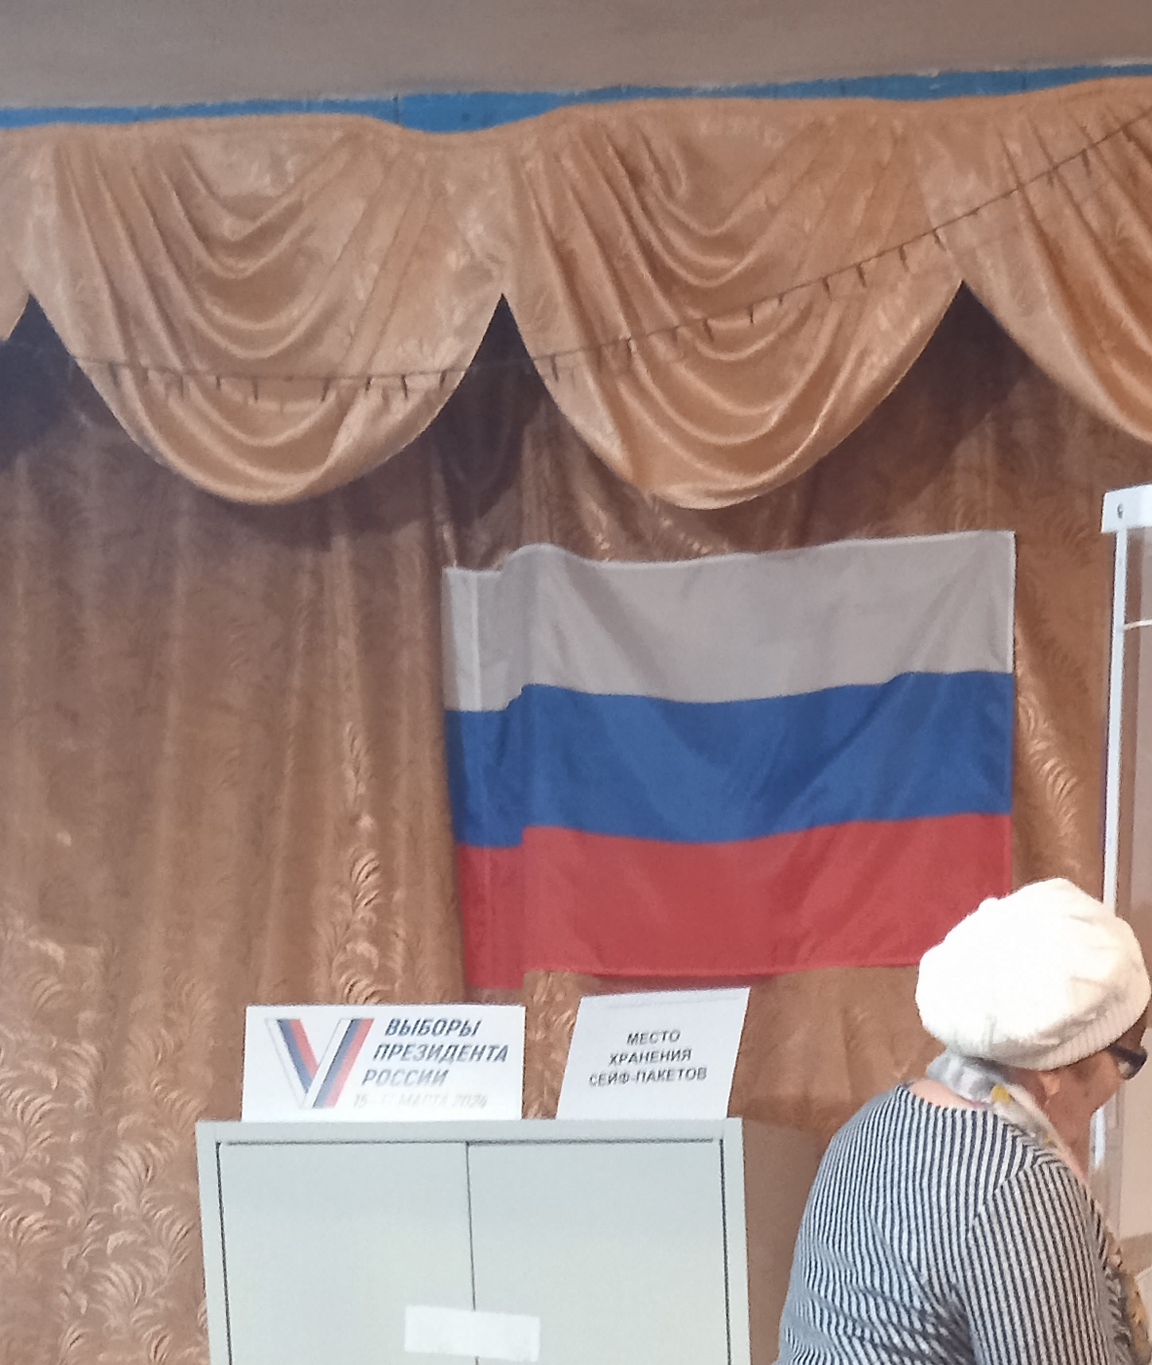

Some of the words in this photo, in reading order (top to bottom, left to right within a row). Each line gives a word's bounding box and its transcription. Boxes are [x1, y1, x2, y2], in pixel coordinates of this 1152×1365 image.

[384, 1018, 482, 1037] ВЫБОРЫ
[626, 1029, 681, 1046] МЕСТО
[372, 1043, 509, 1065] ПРЕЗИДЕНТА
[608, 1047, 692, 1067] ХРАНЕНИЯ
[361, 1068, 449, 1087] РОССИИ
